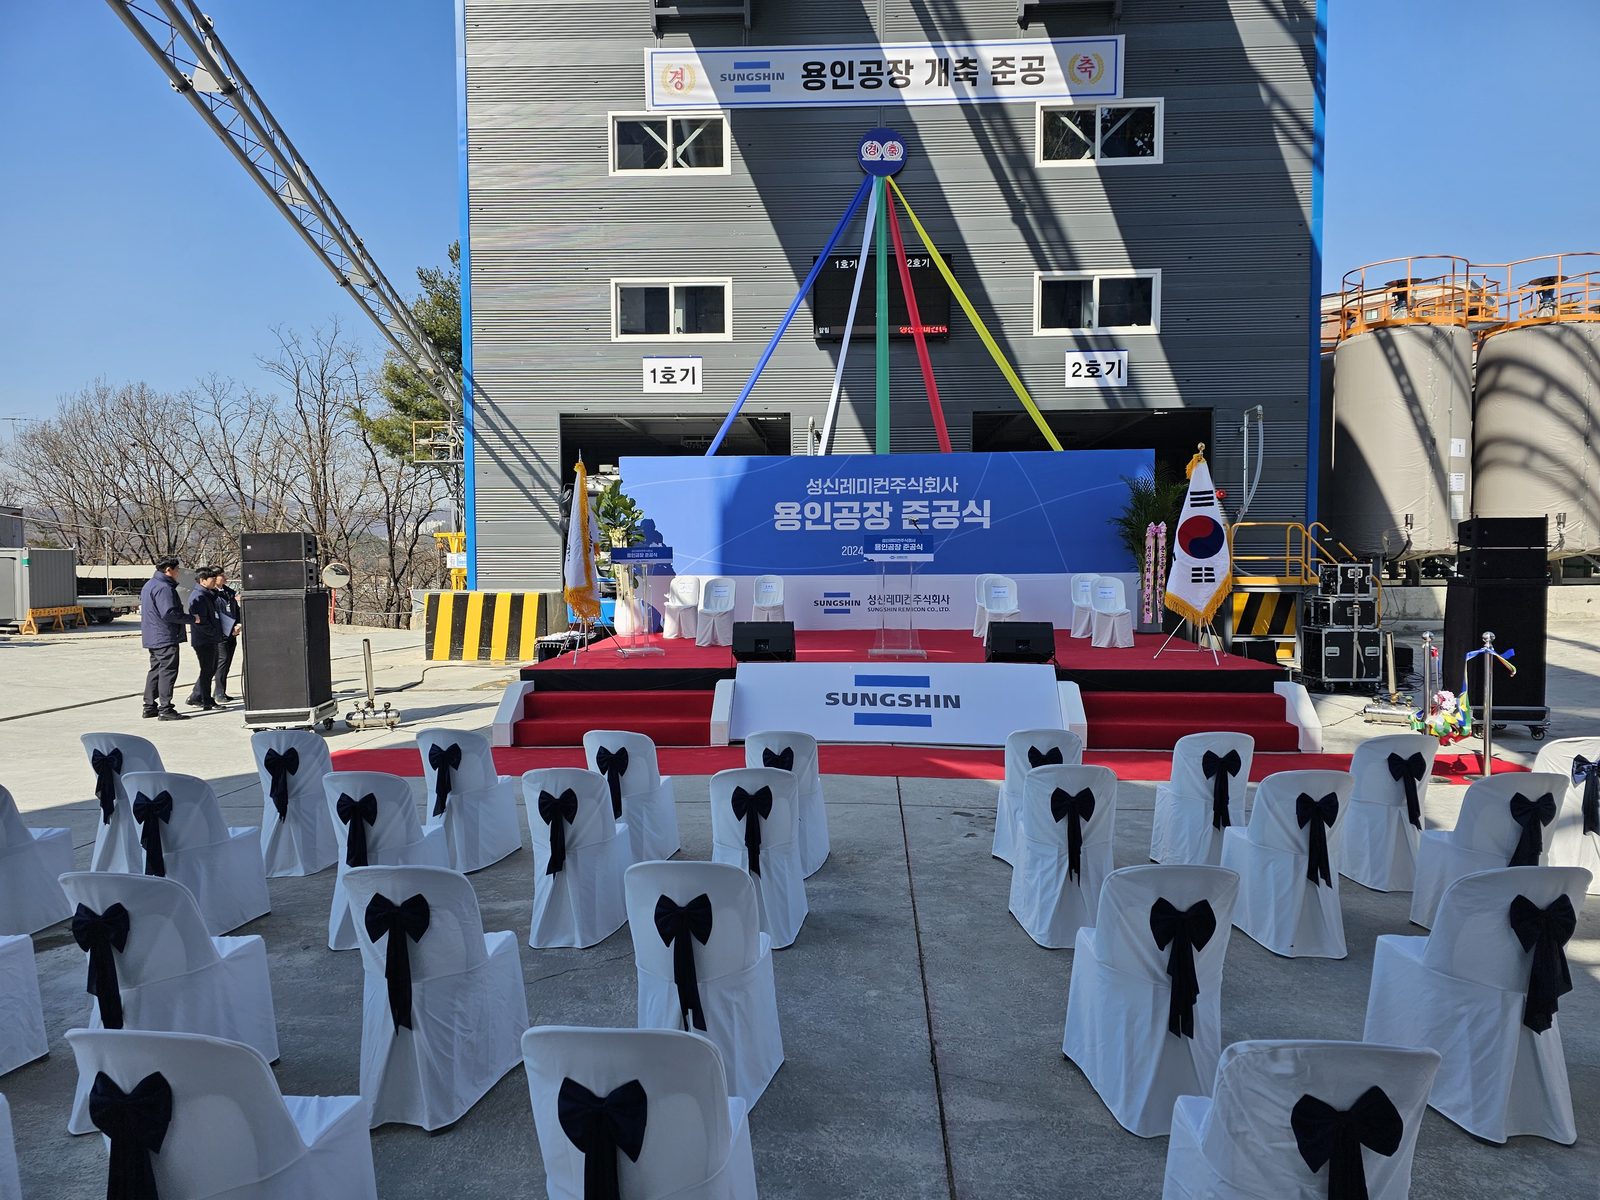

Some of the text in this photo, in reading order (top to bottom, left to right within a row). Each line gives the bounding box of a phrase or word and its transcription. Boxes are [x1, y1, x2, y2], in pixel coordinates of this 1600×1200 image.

[801, 55, 1046, 91] 용인공장 개축 준공
[1077, 56, 1095, 79] 축
[669, 67, 685, 91] 경
[720, 72, 785, 82] SUNGSHIN
[835, 259, 858, 269] 1호기
[907, 258, 930, 268] 2호기
[650, 366, 696, 386] 1호기
[1071, 359, 1122, 379] 2호기
[806, 476, 959, 496] 성신레미컨주식회사
[773, 499, 991, 531] 용인공장 준공식
[841, 545, 864, 556] 2024
[874, 543, 923, 551] 용인공장 준공식
[867, 594, 951, 606] 성신레미컨주식회사
[825, 692, 961, 709] SUNGSHIN
